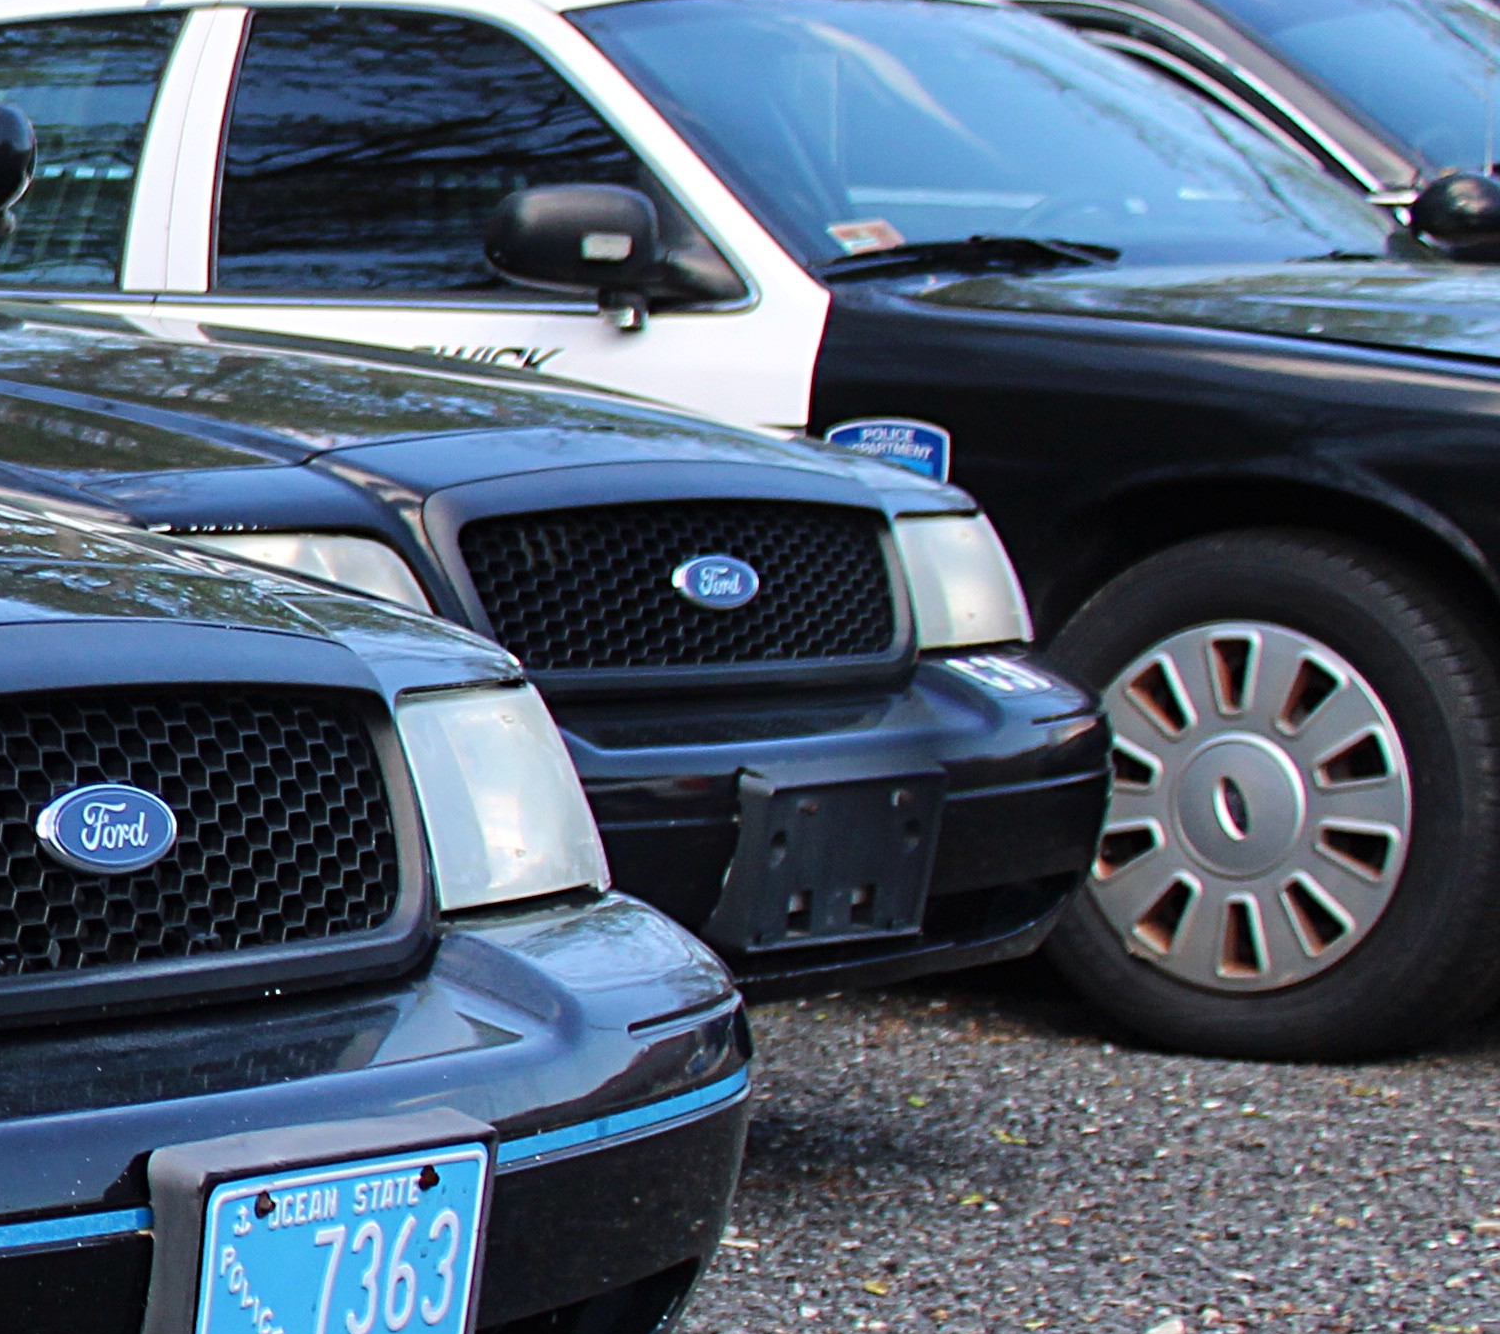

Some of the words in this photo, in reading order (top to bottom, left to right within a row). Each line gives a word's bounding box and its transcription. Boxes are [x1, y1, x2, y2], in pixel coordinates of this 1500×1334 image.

[851, 441, 934, 460] PARTMENT
[861, 427, 916, 442] POLICE
[699, 565, 742, 597] Ford
[80, 801, 149, 852] Ford
[268, 1187, 339, 1230] OCEAN
[353, 1174, 420, 1216] STATE
